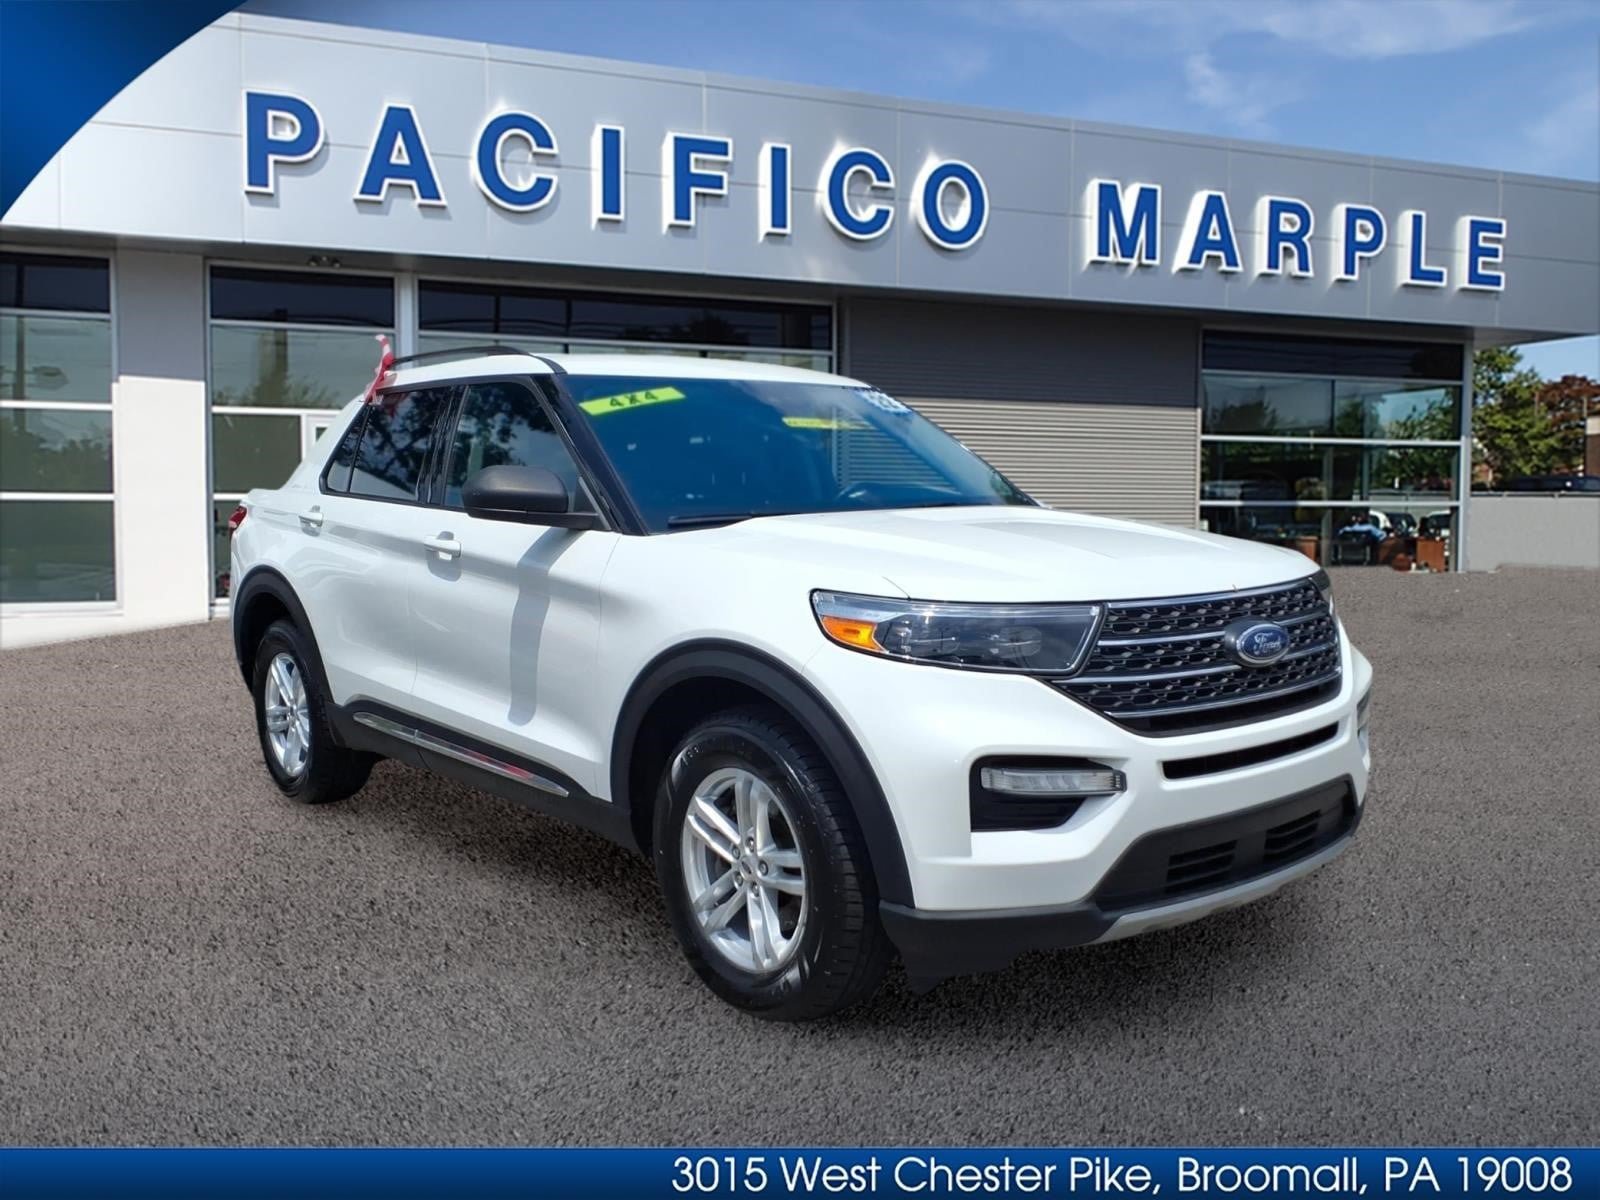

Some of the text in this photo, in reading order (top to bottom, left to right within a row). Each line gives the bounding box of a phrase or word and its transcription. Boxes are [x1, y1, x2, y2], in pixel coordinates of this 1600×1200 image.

[244, 90, 1506, 290] PACIFICO MARPLE
[1254, 632, 1281, 654] Ford
